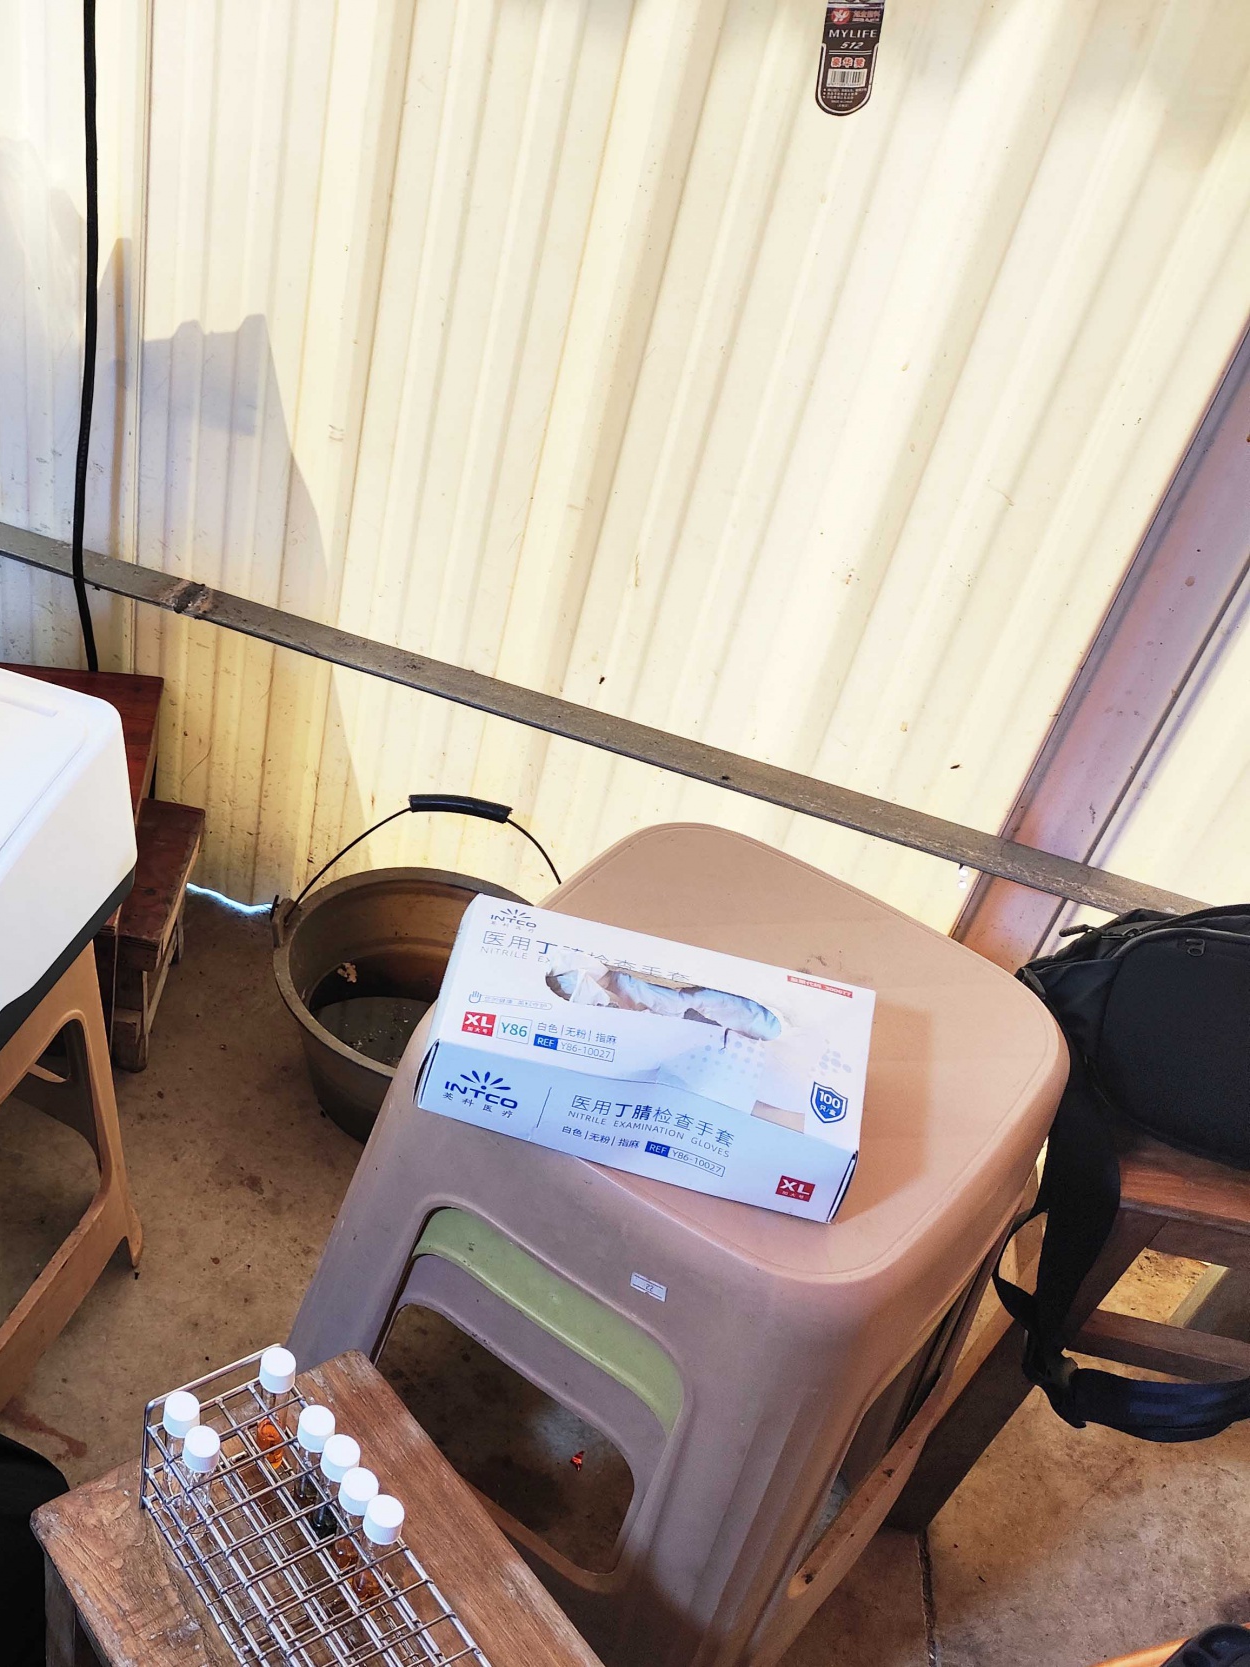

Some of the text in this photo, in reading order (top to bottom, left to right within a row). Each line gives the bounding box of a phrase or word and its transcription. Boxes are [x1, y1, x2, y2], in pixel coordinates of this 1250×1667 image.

[829, 29, 878, 38] MYLIFE
[840, 41, 864, 50] 512
[490, 914, 537, 928] INTCO
[480, 946, 528, 960] NITRILE
[464, 1013, 493, 1028] XL
[500, 1021, 528, 1038] Y86
[537, 1037, 611, 1060] REF Y86-10027
[444, 1081, 518, 1110] INTCO
[819, 1090, 841, 1109] 100
[443, 1092, 513, 1119] 英科医疗
[571, 1094, 735, 1148] 医用丁腈检查手套
[568, 1110, 730, 1158] NITRILE EXAMINATION GLOVES
[649, 1144, 722, 1173] REF Y86-10027
[779, 1178, 810, 1196] XL
